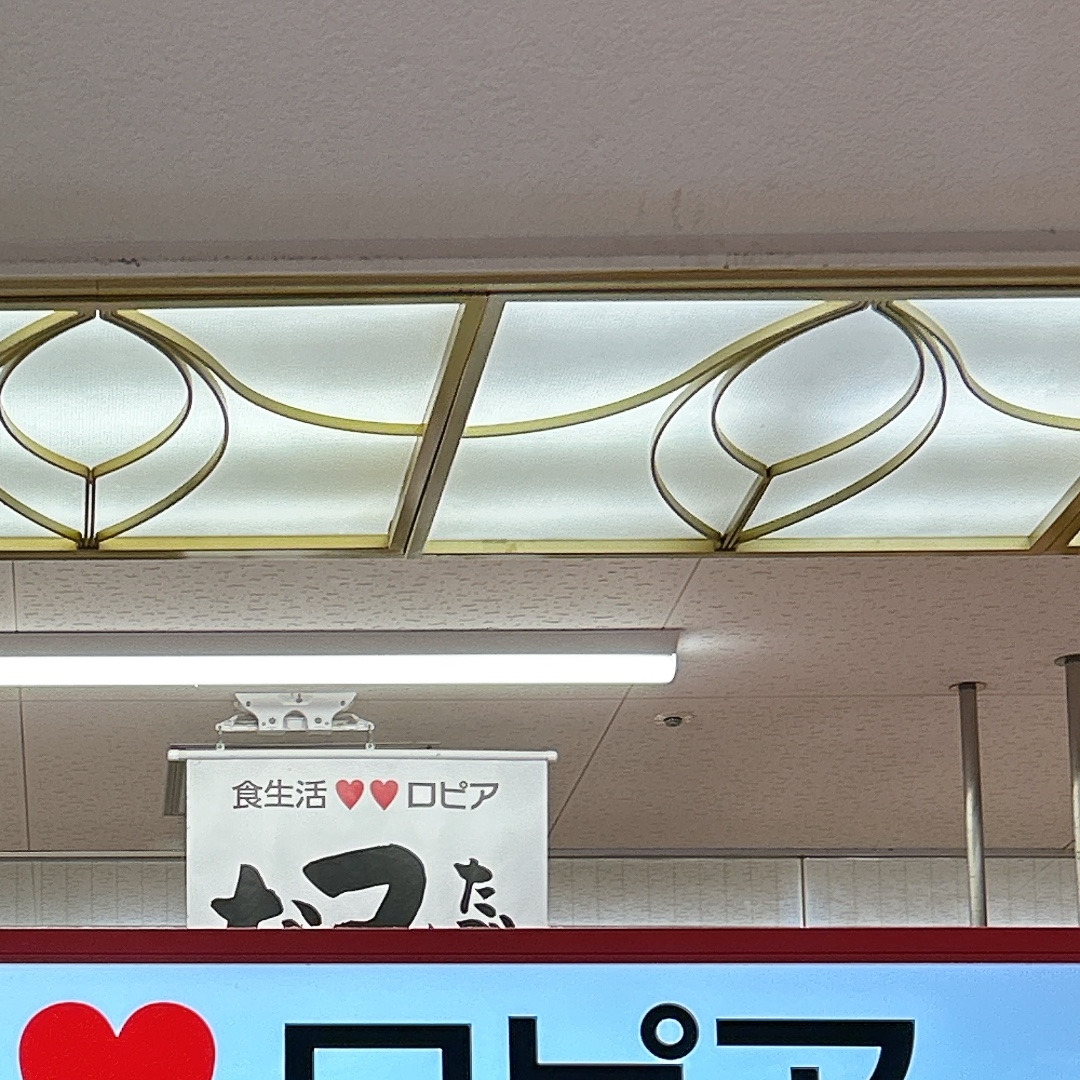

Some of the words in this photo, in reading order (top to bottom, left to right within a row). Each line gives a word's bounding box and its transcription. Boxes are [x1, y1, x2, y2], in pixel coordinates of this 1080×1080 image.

[232, 779, 326, 810] 食生活
[407, 781, 499, 811] ロピア
